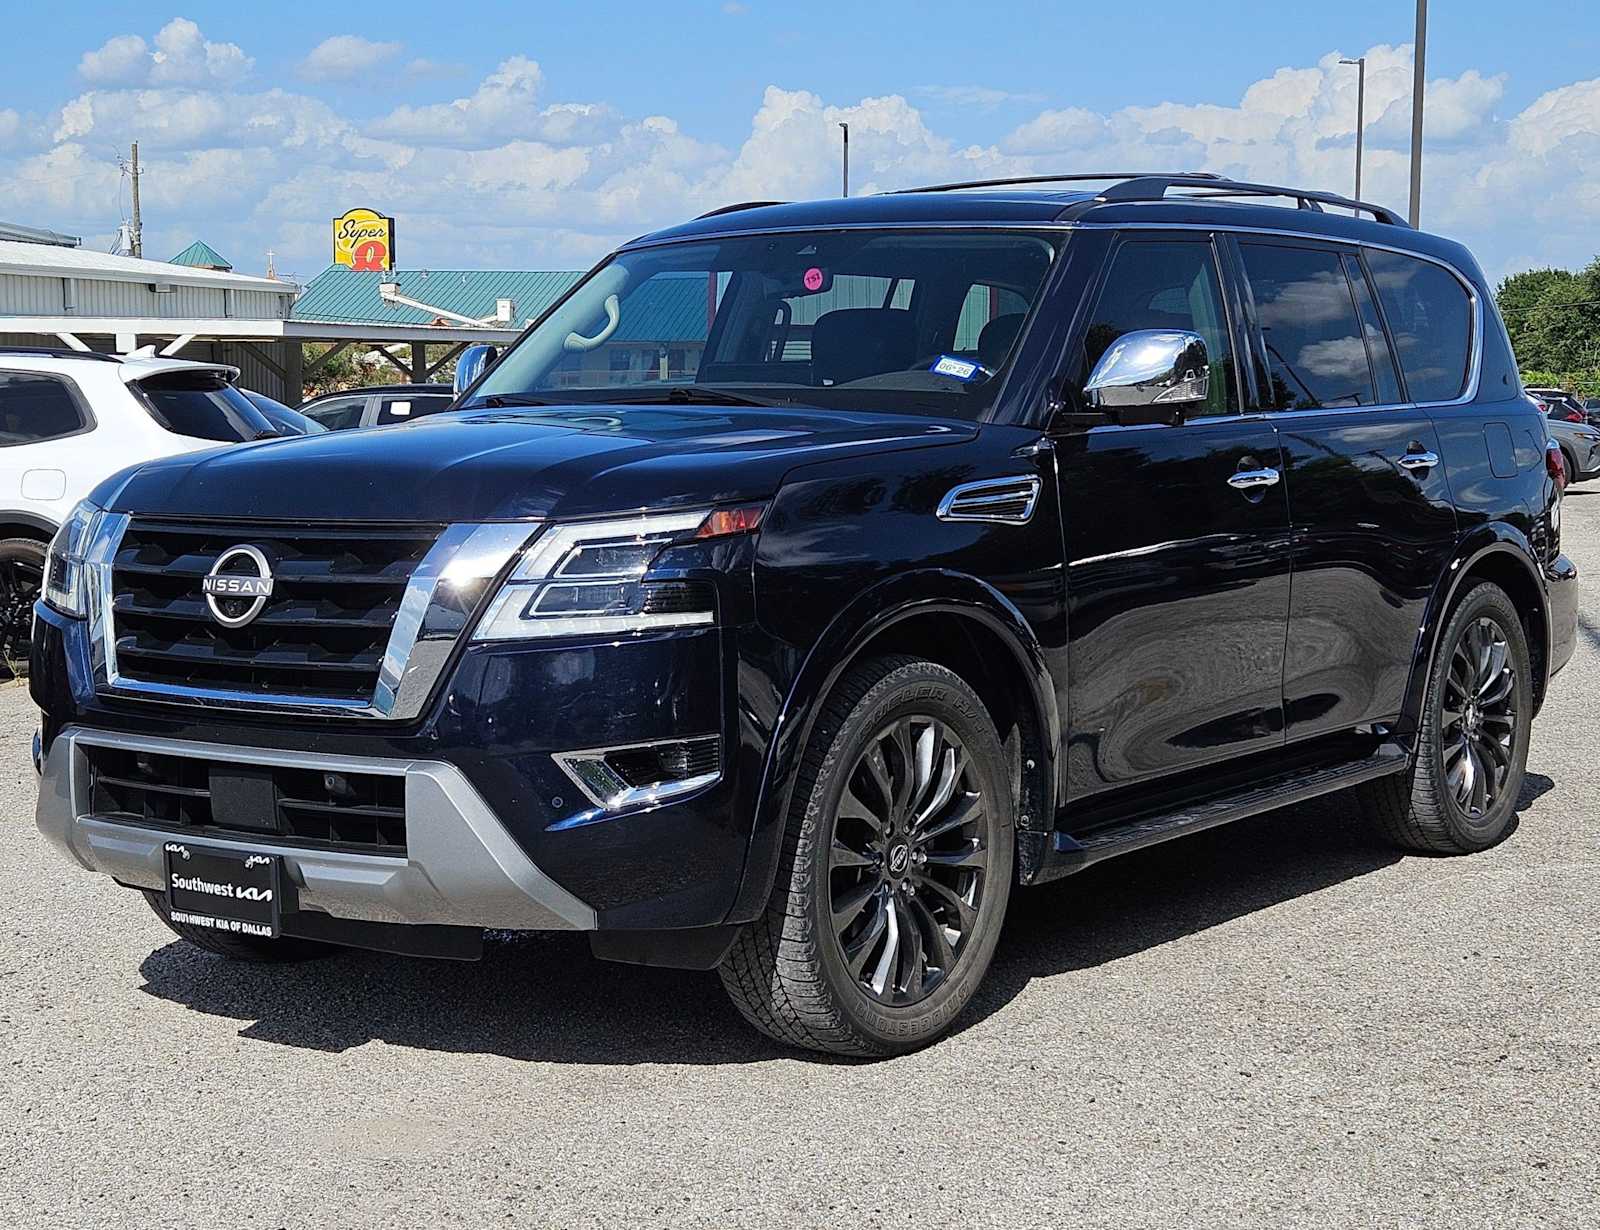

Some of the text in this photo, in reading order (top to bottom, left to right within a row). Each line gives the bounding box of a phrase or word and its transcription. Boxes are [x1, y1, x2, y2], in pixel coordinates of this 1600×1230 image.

[338, 219, 386, 248] Super
[202, 578, 271, 593] NISSAN
[171, 873, 234, 897] Southwest
[170, 911, 272, 937] SOUTHWEST KIA OF DALLAS
